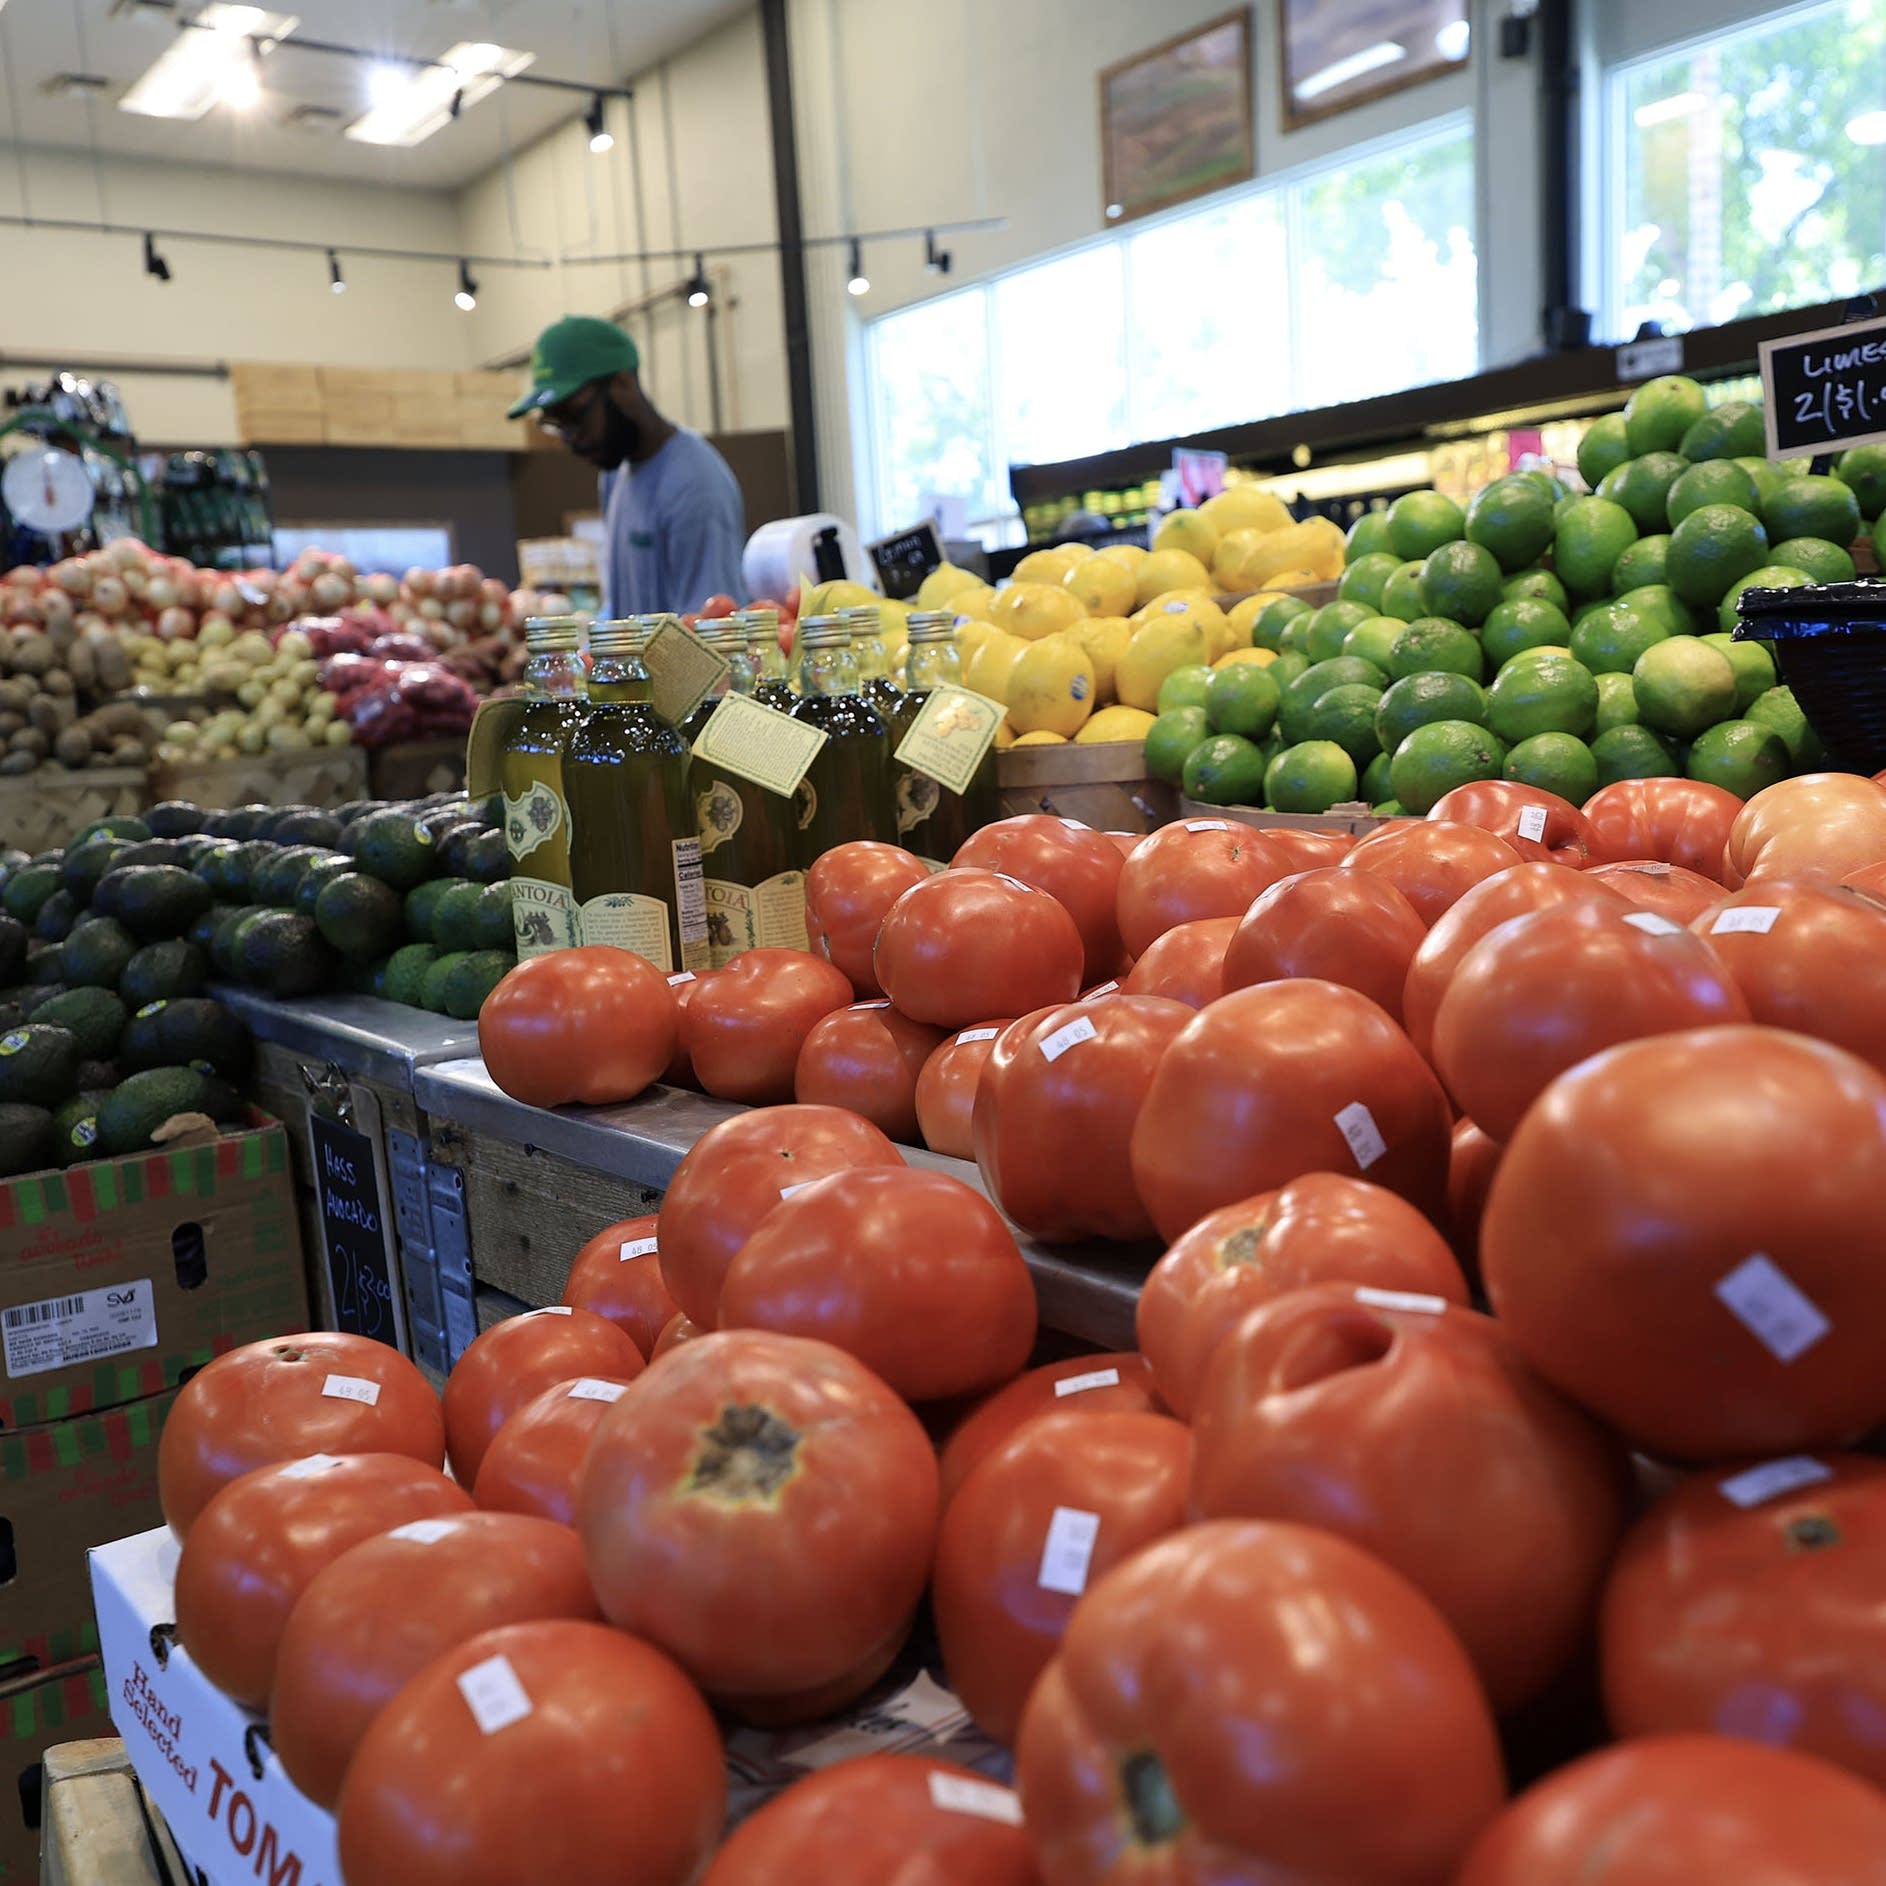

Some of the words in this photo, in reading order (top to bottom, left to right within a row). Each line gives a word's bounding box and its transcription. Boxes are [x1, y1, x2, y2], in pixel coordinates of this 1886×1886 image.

[324, 1143, 357, 1187] HASS
[327, 1187, 379, 1233] AVOCADO
[123, 1678, 198, 1793] Selected
[132, 1660, 182, 1742] Hand
[208, 1757, 321, 1886] TOM
